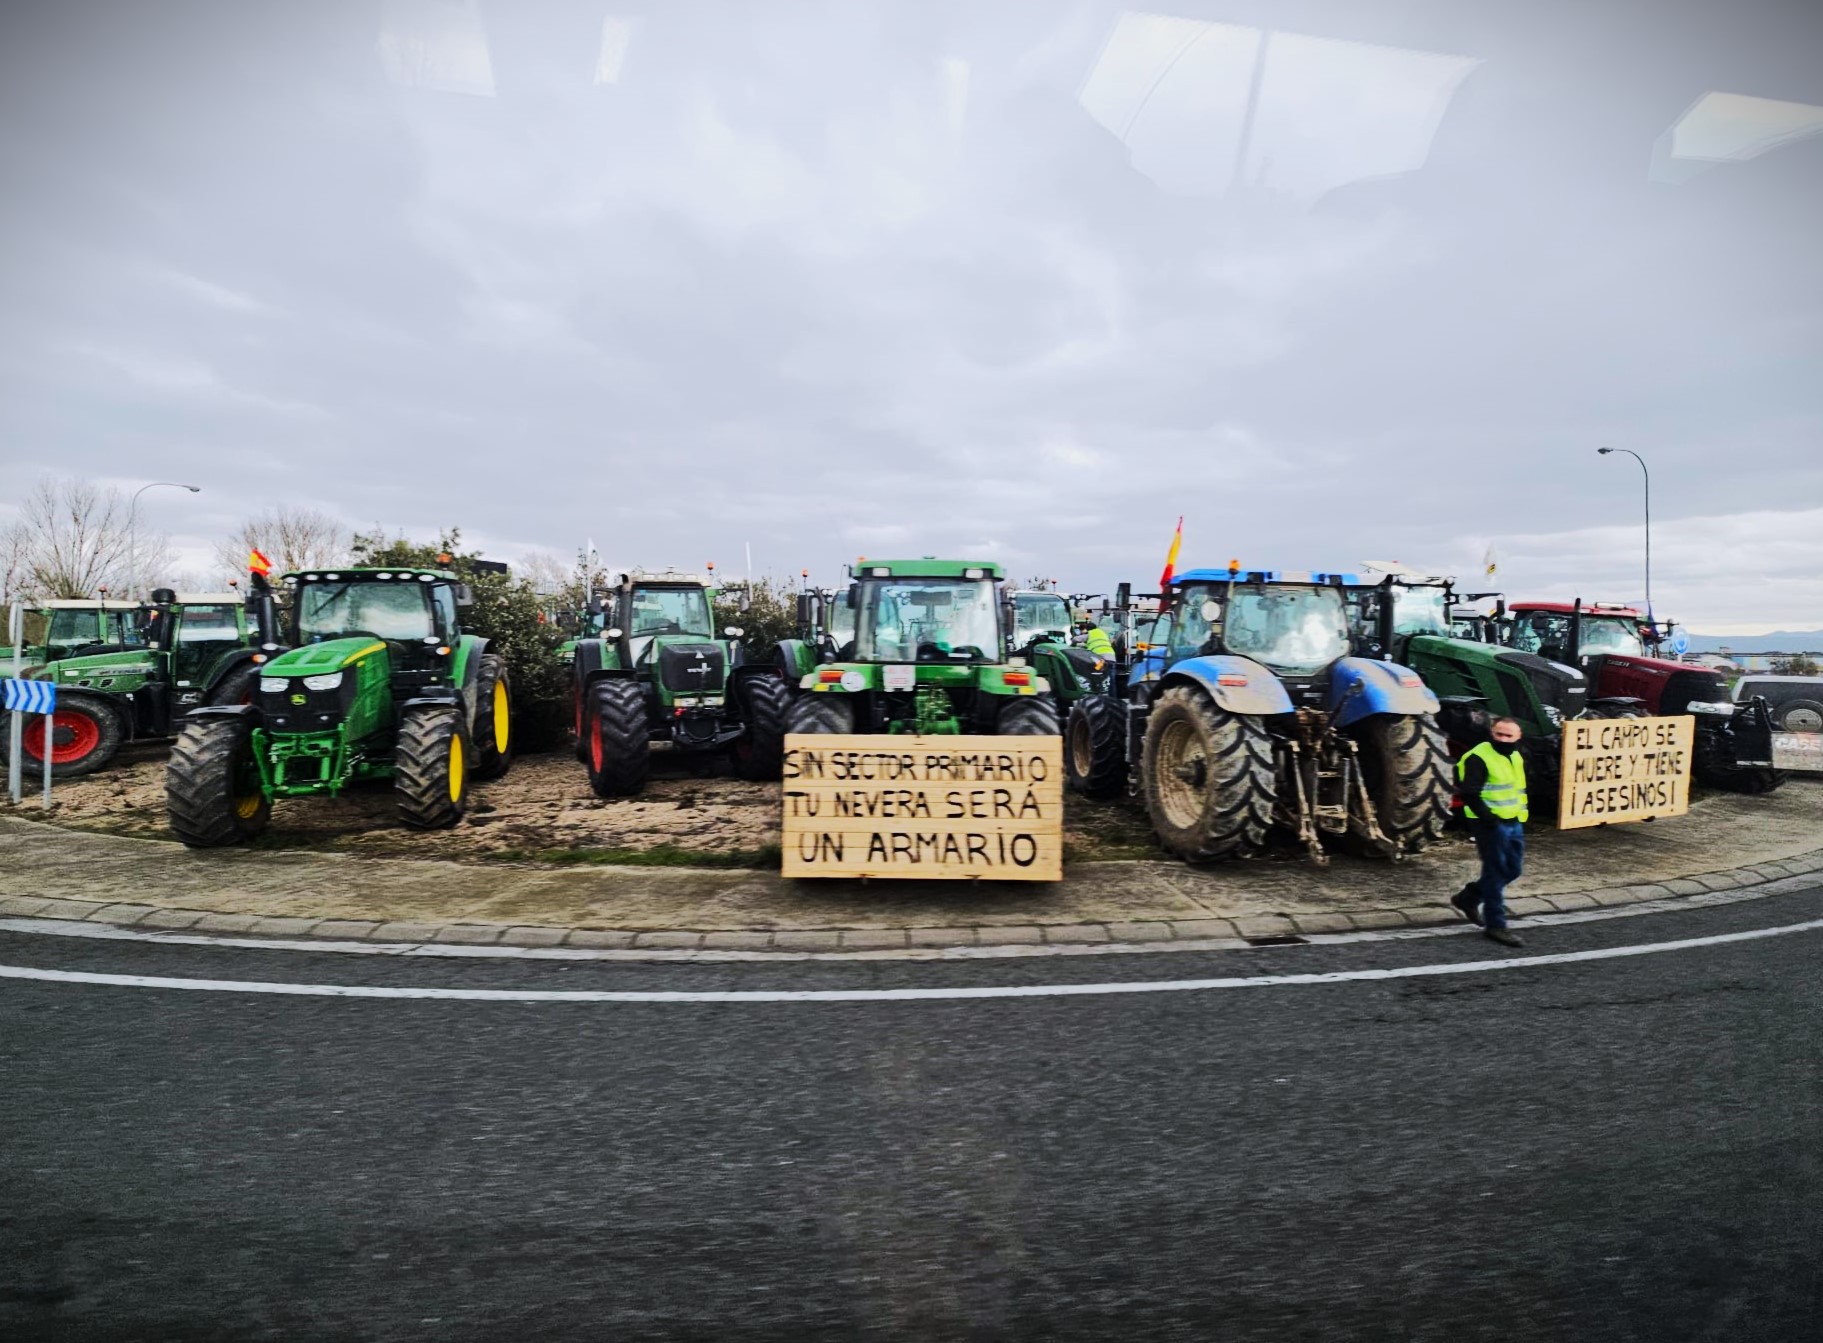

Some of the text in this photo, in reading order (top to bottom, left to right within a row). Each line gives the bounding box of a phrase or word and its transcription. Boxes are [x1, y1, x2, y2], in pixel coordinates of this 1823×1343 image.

[1576, 724, 1676, 750] EL CAMPO SE
[783, 748, 1048, 782] SIN SECTOR PRIMARIO
[1574, 749, 1683, 783] MUERE Y TIENE
[784, 782, 1042, 819] TU NEVERA SERÁ
[799, 826, 1037, 867] UN ARMARIO
